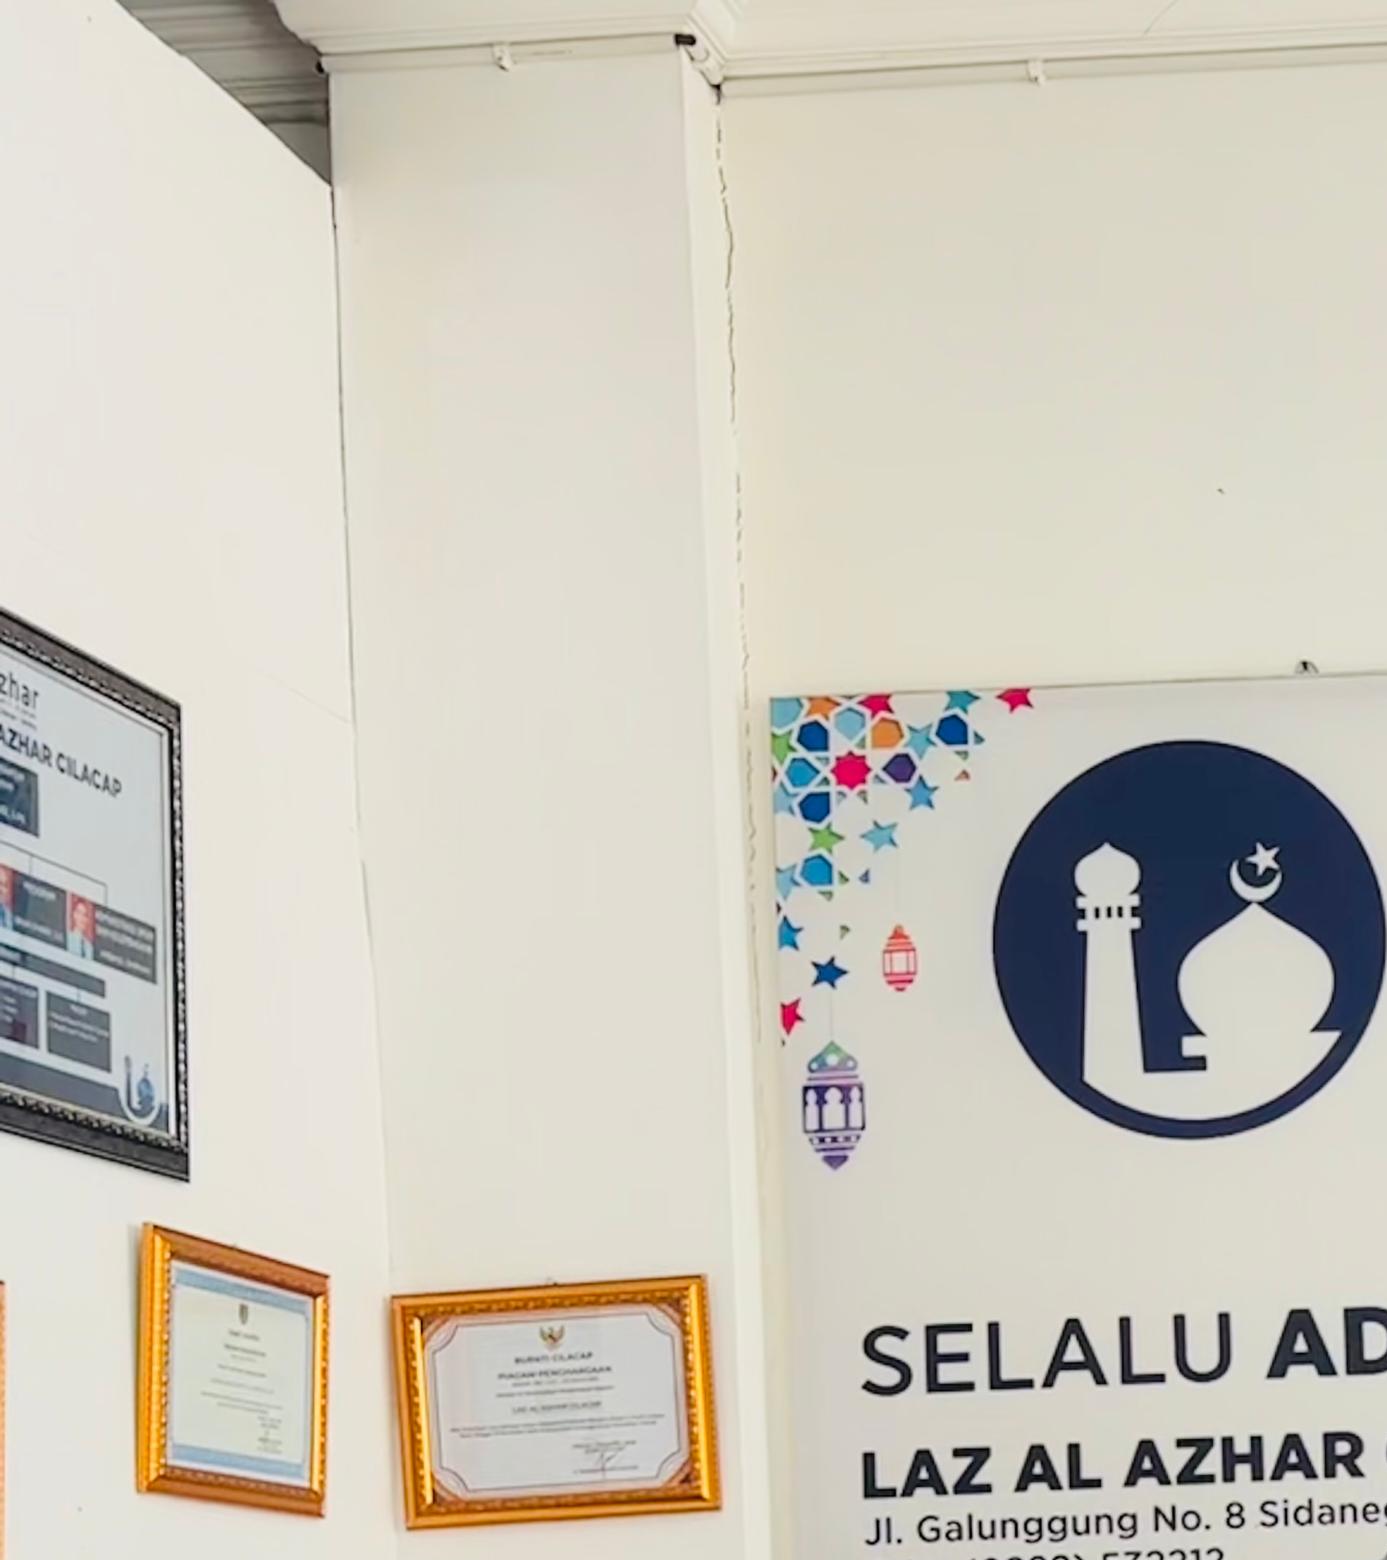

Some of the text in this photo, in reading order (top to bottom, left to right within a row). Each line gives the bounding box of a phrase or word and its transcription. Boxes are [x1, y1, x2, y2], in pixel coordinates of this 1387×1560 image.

[56, 752, 122, 798] CILACAP
[861, 1312, 1231, 1397] SELALU
[862, 1447, 992, 1499] LAZ
[1014, 1443, 1102, 1493] AL
[1124, 1431, 1365, 1488] AZHAR
[866, 1517, 902, 1546] Jl.
[917, 1508, 1139, 1546] Galunggung
[1153, 1505, 1211, 1534] No.
[1225, 1502, 1246, 1530] 8
